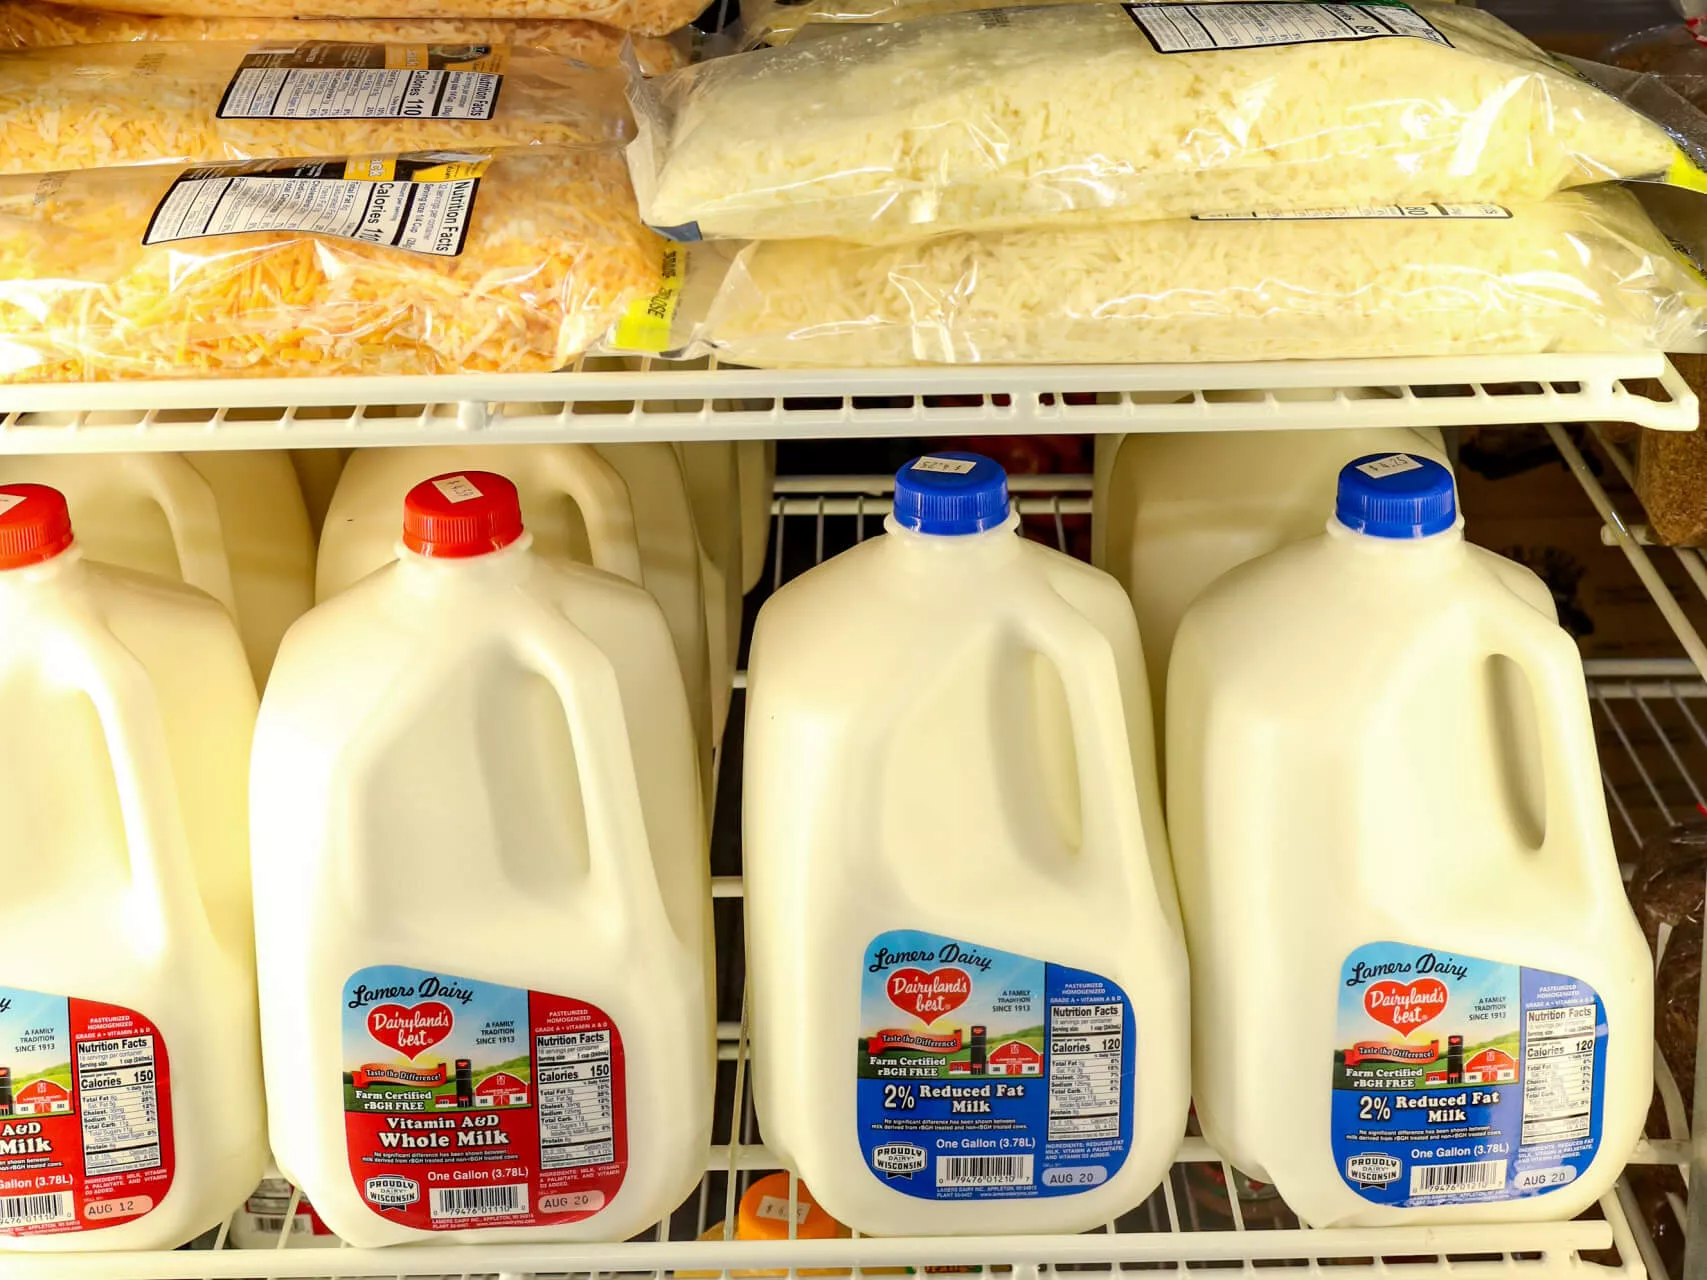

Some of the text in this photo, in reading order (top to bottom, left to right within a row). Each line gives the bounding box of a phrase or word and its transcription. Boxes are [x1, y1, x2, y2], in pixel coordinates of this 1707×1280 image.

[404, 70, 430, 116] Calories 110
[368, 182, 394, 224] Calories
[436, 182, 471, 252] Nutrition Facts
[869, 943, 992, 972] Lamers Dairy
[1346, 953, 1468, 986] Lamers Dairy
[348, 977, 474, 1008] Lamers Dairy
[892, 976, 968, 999] Dairyland's
[916, 994, 945, 1012] best
[1370, 988, 1444, 1012] Dairyland's
[1053, 1006, 1118, 1018] Nutrition Facts
[1393, 1006, 1422, 1024] best
[373, 1010, 450, 1034] Dairyland's
[397, 1030, 427, 1046] best
[476, 1036, 515, 1045] SINCE 1913
[537, 1032, 604, 1047] Nutrition Facts
[1052, 1038, 1121, 1053] Calories 120
[15, 1044, 55, 1053] SINCE 1913
[78, 1038, 148, 1054] Nutrition Facts
[1527, 1040, 1594, 1058] Calories 120
[870, 1056, 946, 1066] Farm Certified
[539, 1064, 610, 1082] Calories 150
[878, 1067, 938, 1076] rBGH FREE
[80, 1070, 154, 1090] Calories 150
[355, 1090, 432, 1100] Farm Certified
[884, 1084, 1025, 1109] 2% Reduced Fat
[364, 1100, 424, 1110] rBGH FREE
[952, 1100, 991, 1114] Milk
[1359, 1092, 1500, 1120] 2% Reduced Fat
[387, 1114, 500, 1130] Vitamin A&D
[1428, 1110, 1467, 1122] Milk
[2, 1122, 42, 1136] A&D
[0, 1137, 52, 1154] Milk
[378, 1130, 510, 1149] Whole Milk
[936, 1137, 1036, 1150] One Gallon (3.78L)
[1411, 1144, 1509, 1158] One Gallon (3.78L)
[427, 1166, 529, 1180] One Gallon (3.78L)
[1050, 1172, 1094, 1184] AUG 20
[1523, 1172, 1566, 1186] AUG 20
[369, 1180, 414, 1190] PROUDLY
[370, 1192, 416, 1202] WISCONSIN
[543, 1195, 589, 1208] AUG 20
[88, 1202, 134, 1216] AUG 12
